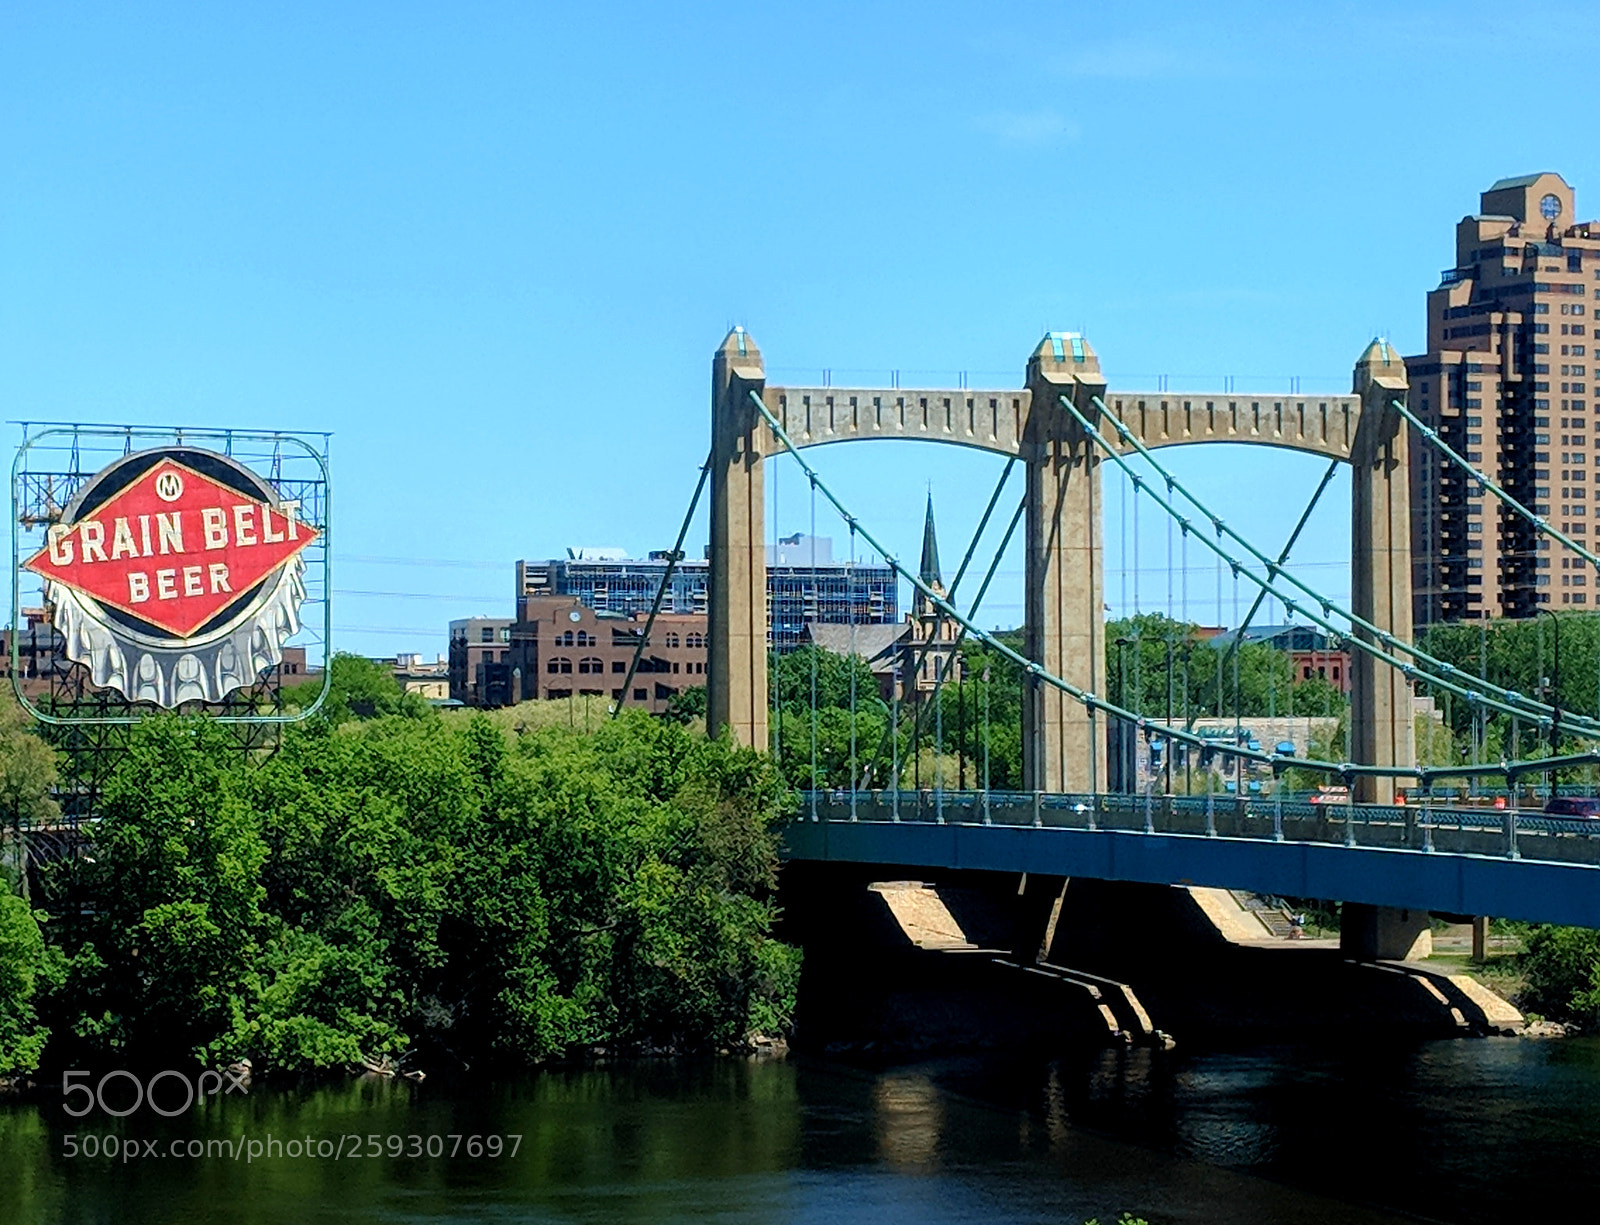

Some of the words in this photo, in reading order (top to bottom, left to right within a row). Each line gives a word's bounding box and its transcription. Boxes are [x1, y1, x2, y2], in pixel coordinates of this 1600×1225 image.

[158, 473, 182, 499] M
[48, 512, 185, 566] GRAIN
[201, 500, 302, 550] BELT
[128, 562, 233, 604] BEER
